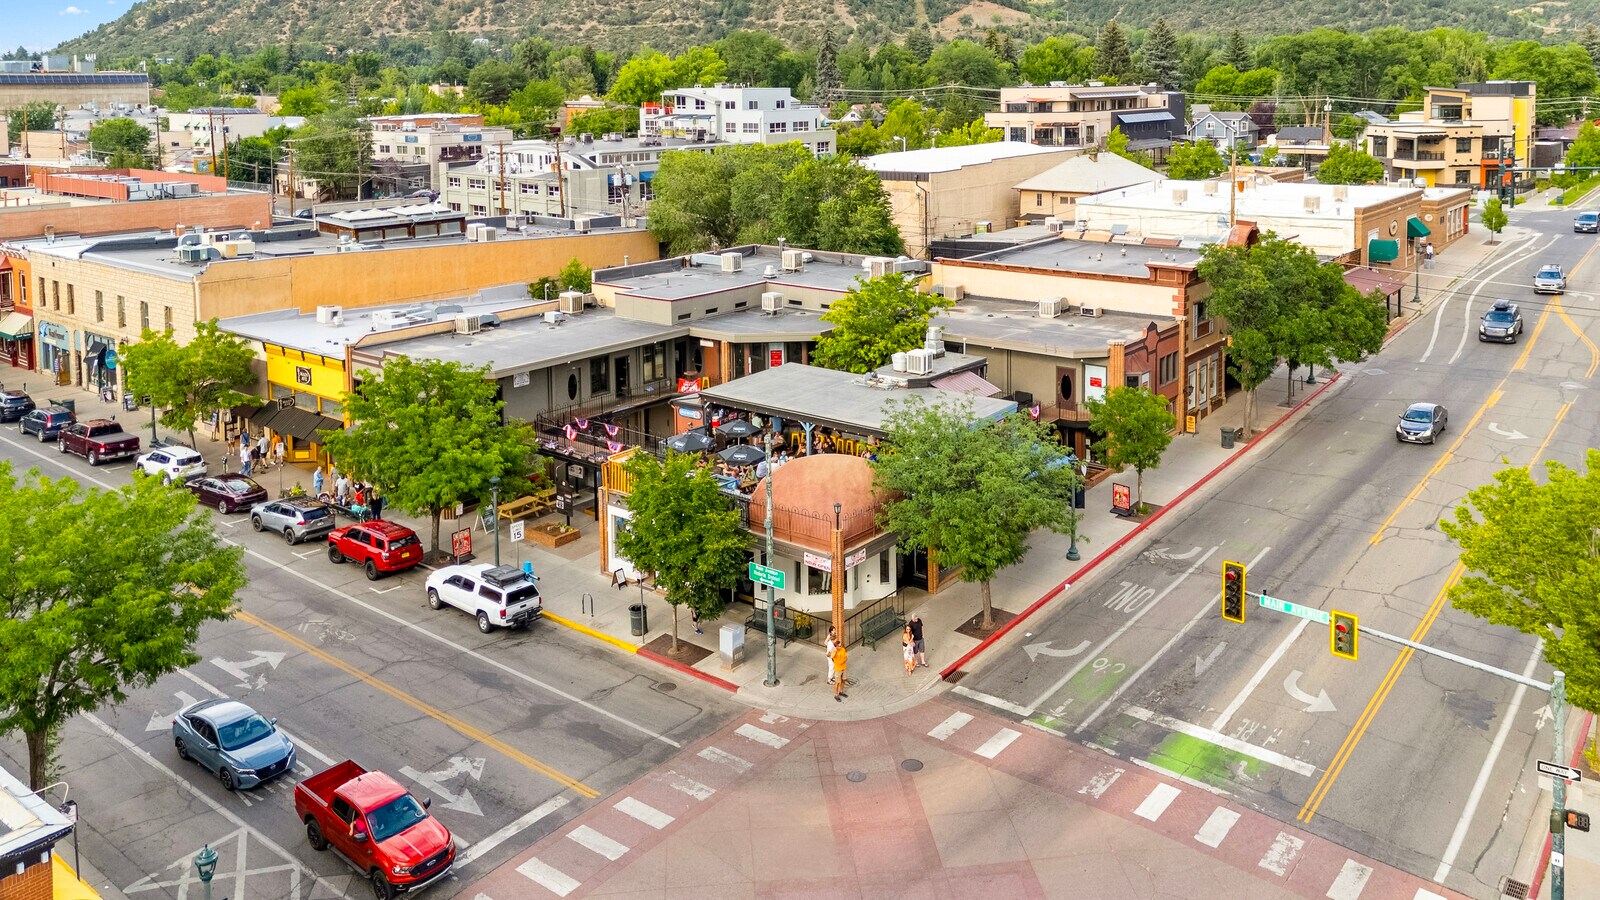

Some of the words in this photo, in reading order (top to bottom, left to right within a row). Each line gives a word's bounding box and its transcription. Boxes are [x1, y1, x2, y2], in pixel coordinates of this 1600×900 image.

[513, 531, 522, 540] 15
[1264, 597, 1285, 612] MAIN
[1291, 605, 1323, 620] AVENUE
